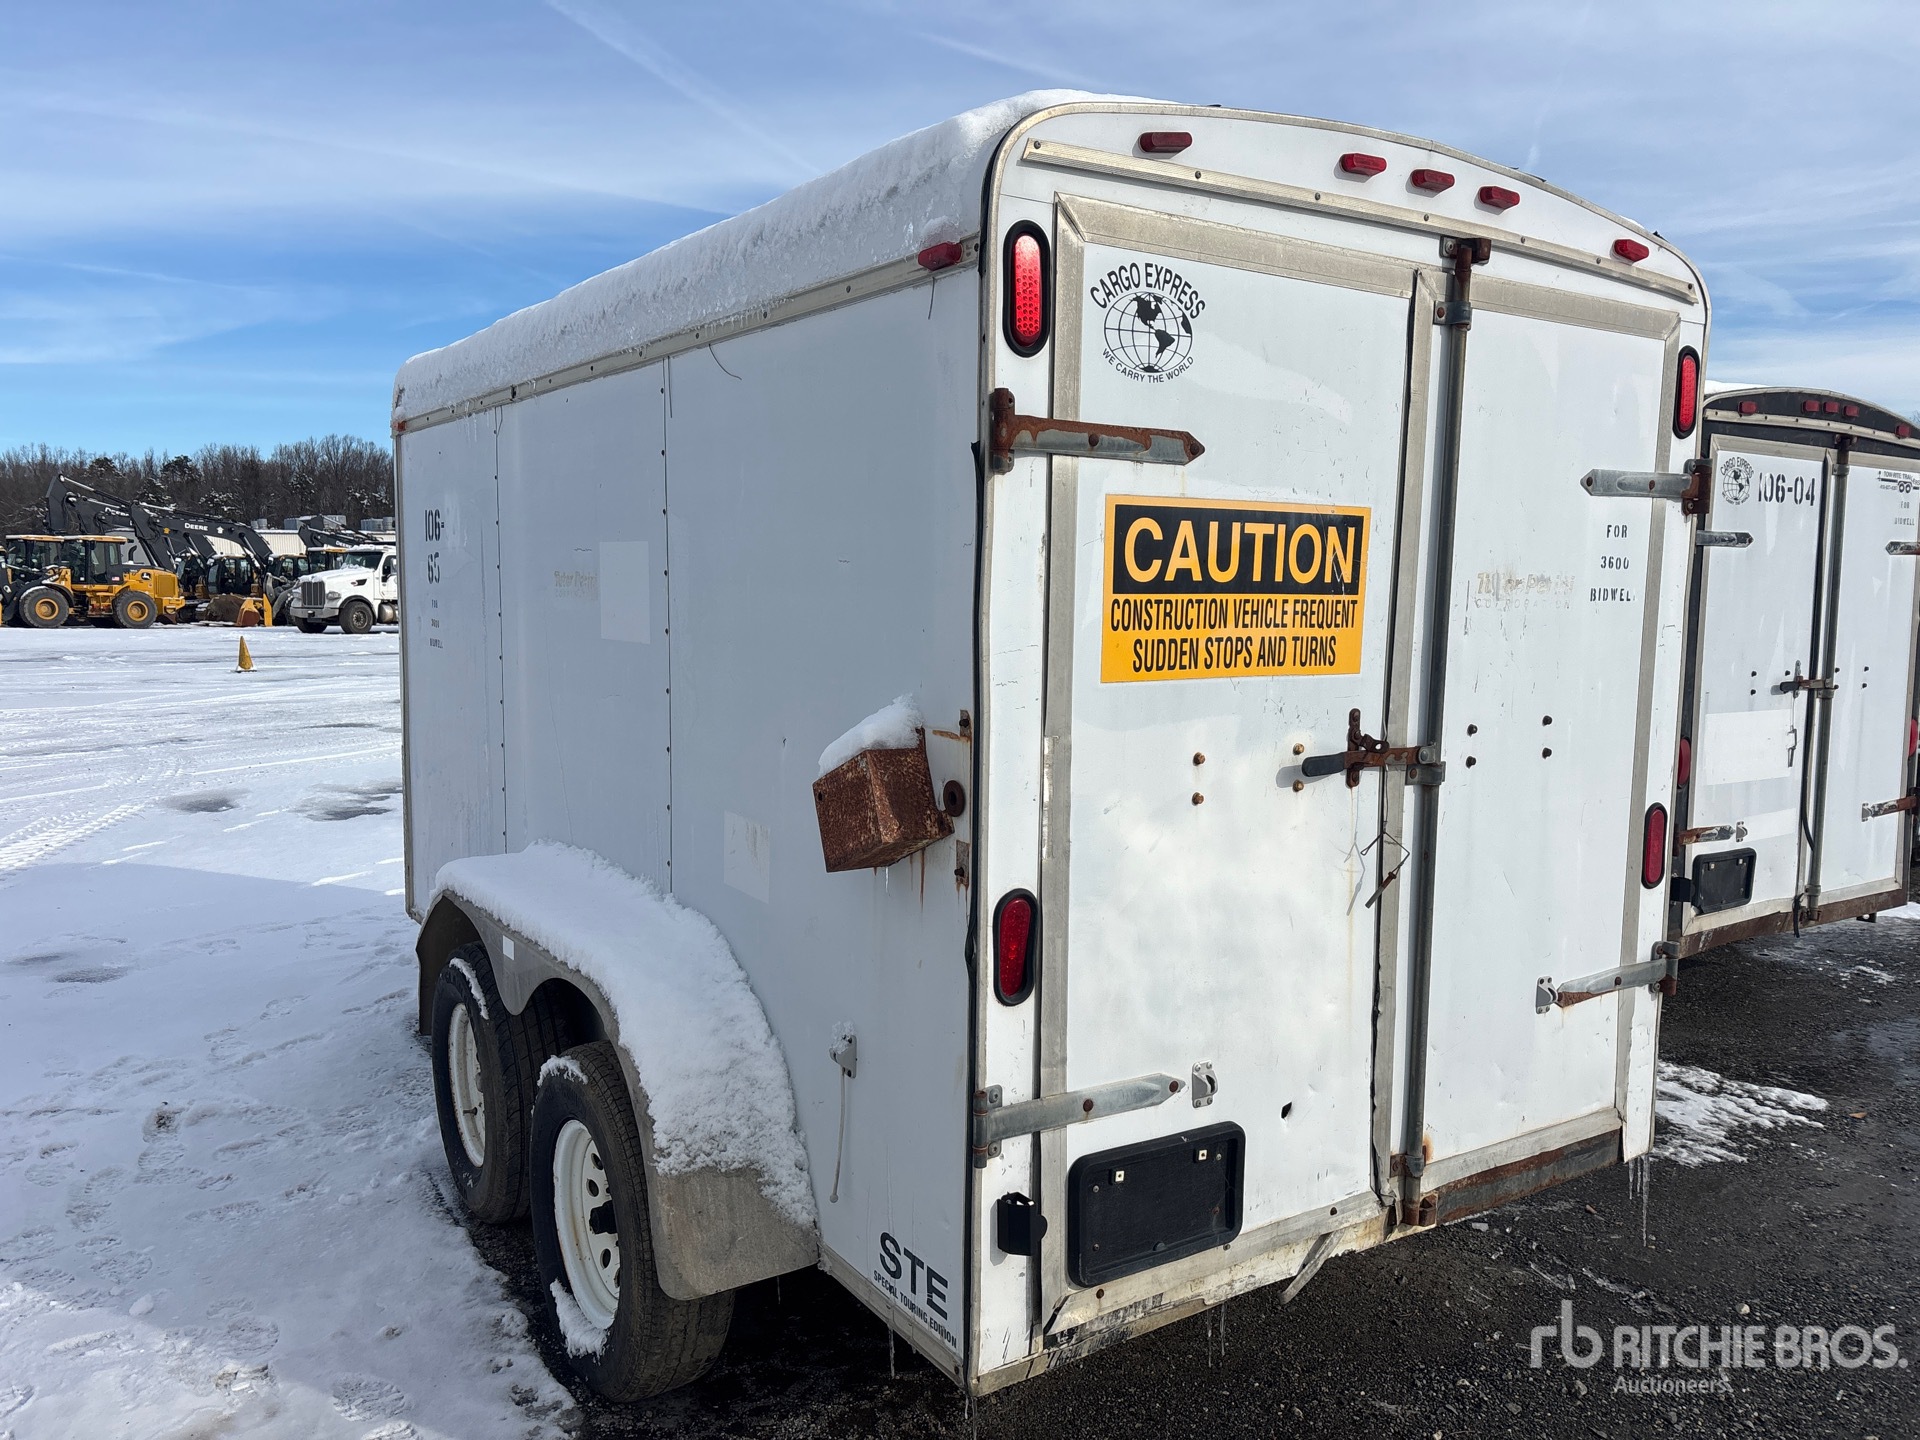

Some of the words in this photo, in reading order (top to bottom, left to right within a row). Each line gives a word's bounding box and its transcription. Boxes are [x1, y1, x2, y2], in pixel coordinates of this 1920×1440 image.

[1090, 262, 1141, 309] CARGO
[1144, 262, 1206, 319] EXPRESS
[1102, 348, 1115, 365] WE
[1115, 362, 1145, 382] CARRY
[1148, 375, 1165, 384] THE
[1165, 356, 1194, 380] WORLD
[1720, 457, 1736, 476] CARGO
[1736, 456, 1754, 479] EXPRESS
[1758, 472, 1815, 506] 106-04
[184, 523, 208, 531] DEERE
[1607, 524, 1627, 538] FOR
[1124, 517, 1355, 583] CAUTION
[1600, 556, 1629, 570] 3600
[1590, 588, 1635, 602] BIDWEL
[1111, 598, 1228, 631] CONSTRUCTION
[1233, 598, 1289, 629] VEHICLE
[1292, 599, 1358, 630] FREQUENT
[1133, 638, 1199, 672] SUDDEN
[1204, 636, 1253, 669] STOPS
[1257, 636, 1287, 667] AND
[1292, 636, 1337, 667] TURNS
[879, 1232, 948, 1321] STE
[873, 1270, 899, 1299] SPECIAL
[900, 1292, 928, 1323] TOURING
[929, 1317, 957, 1349] EDITION
